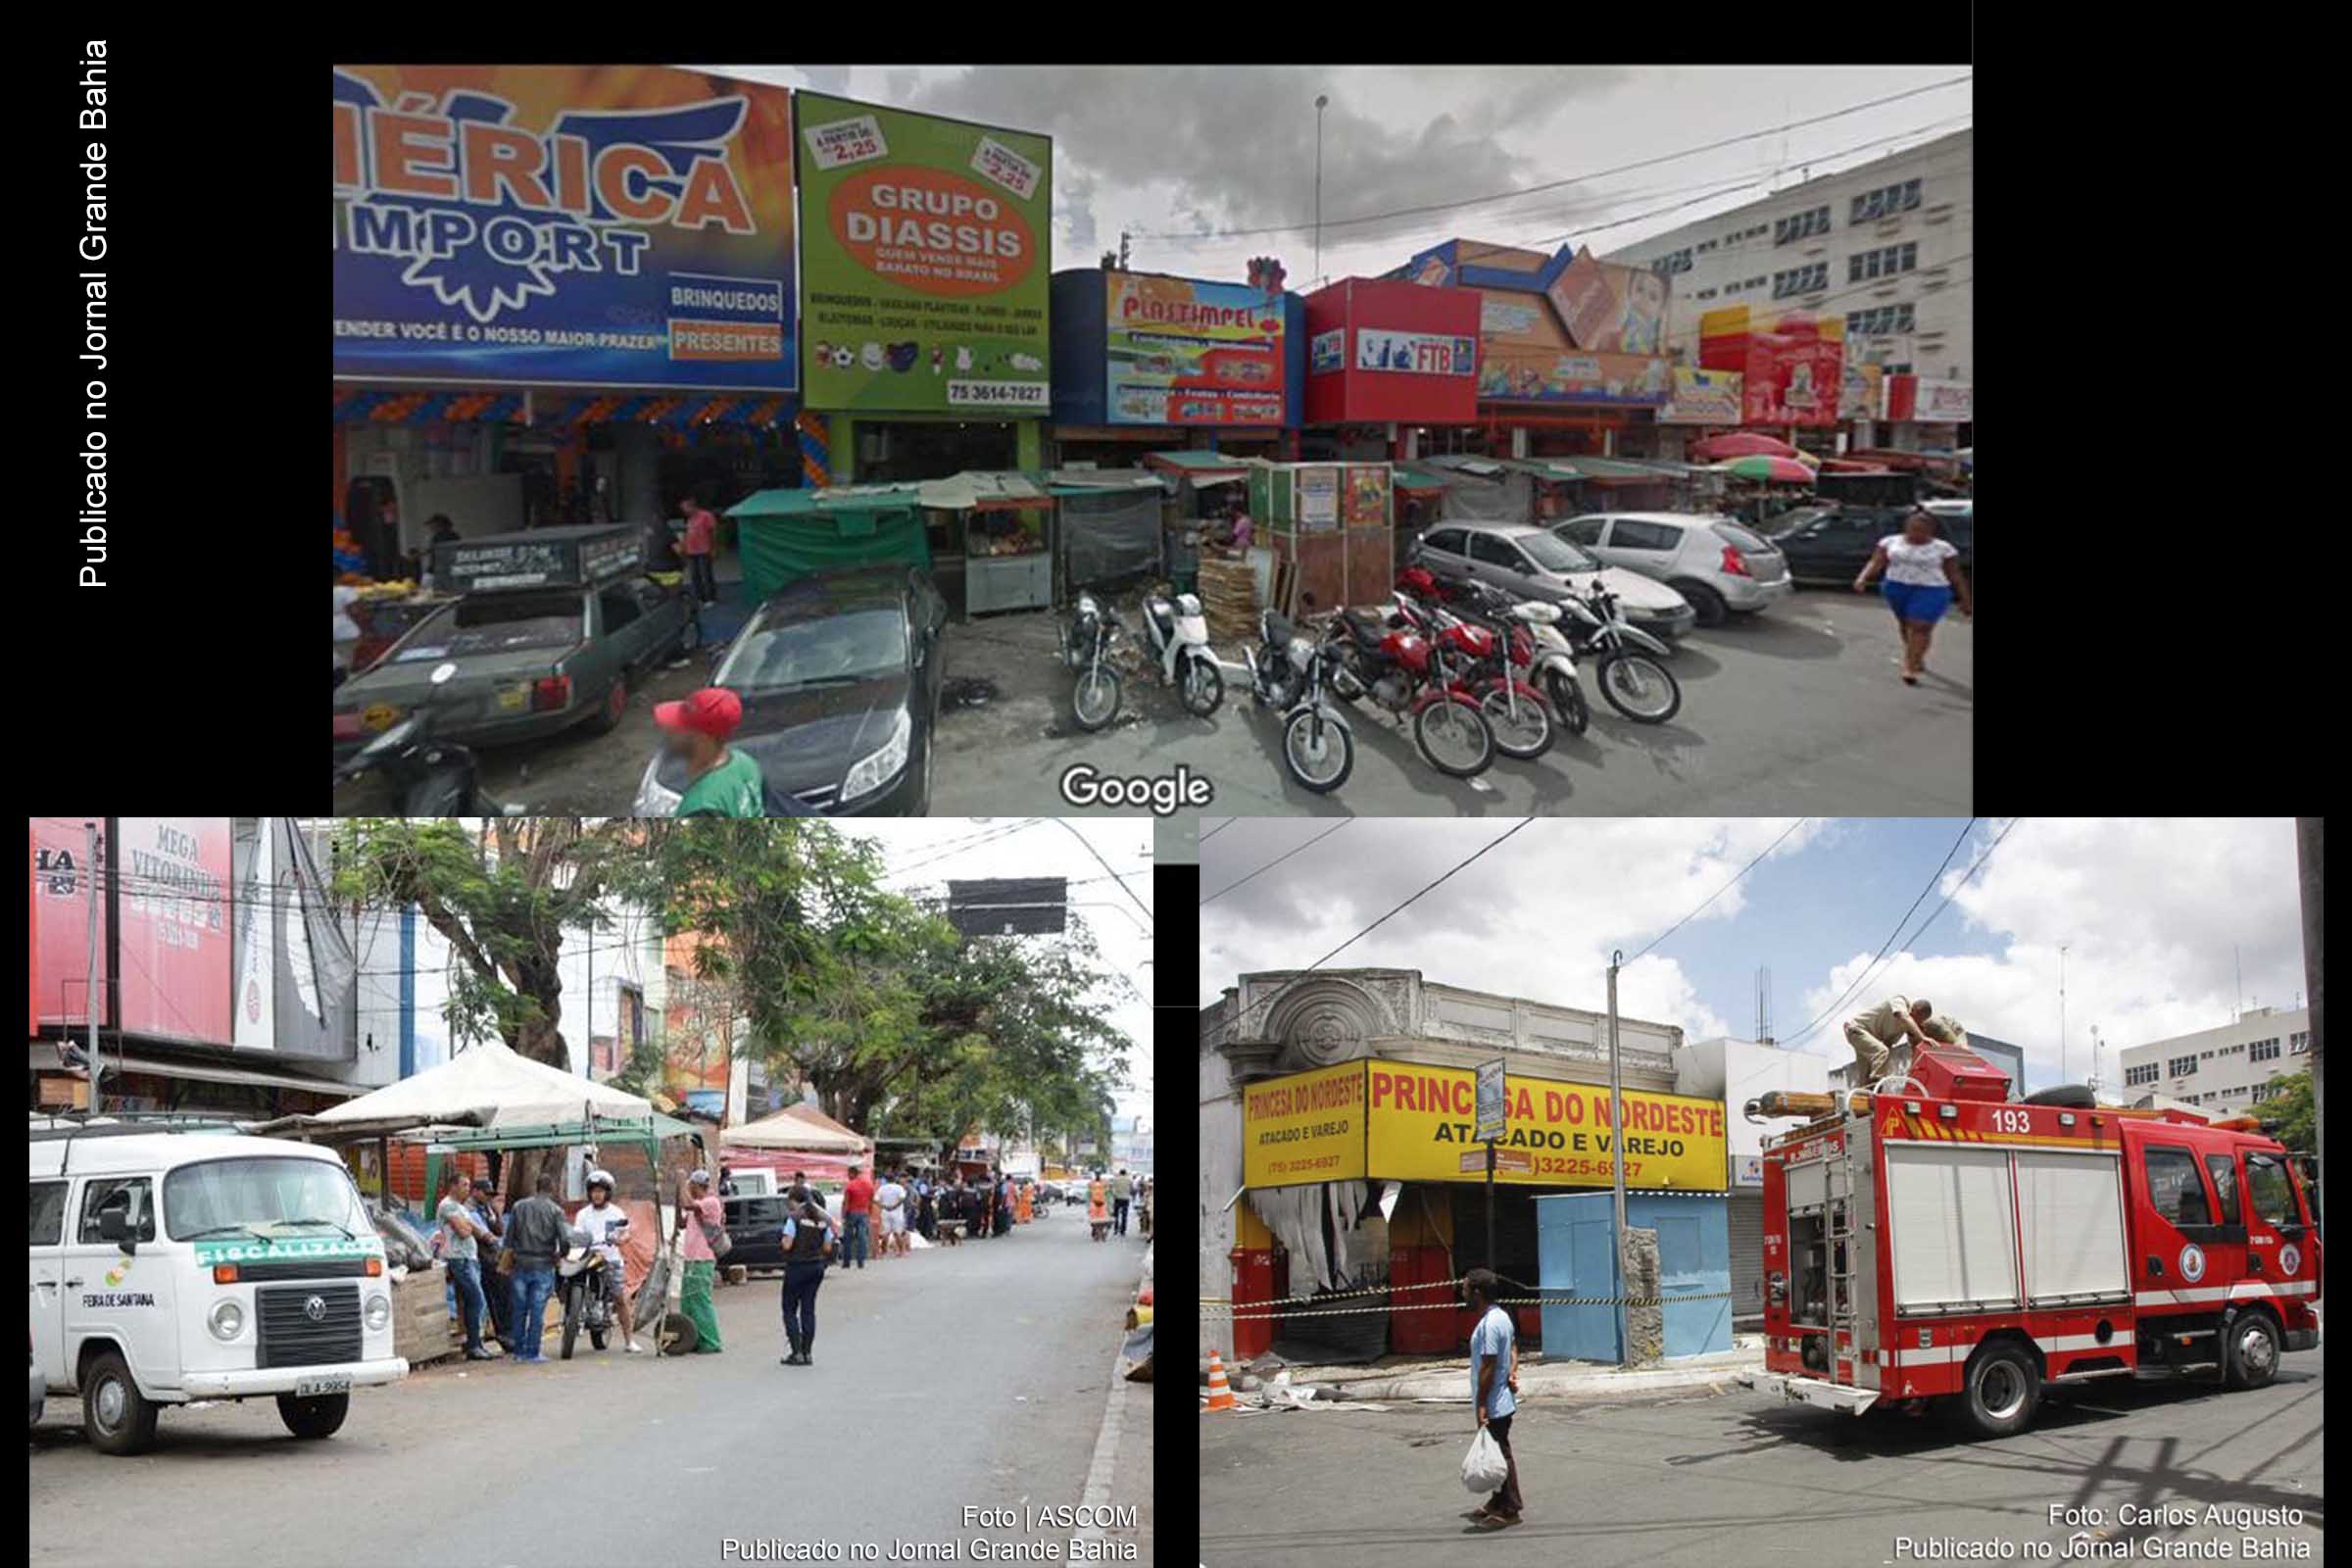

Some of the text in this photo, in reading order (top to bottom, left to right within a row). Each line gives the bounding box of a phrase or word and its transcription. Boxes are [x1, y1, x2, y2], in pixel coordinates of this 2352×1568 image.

[871, 183, 999, 221] GRUPO
[333, 202, 651, 275] MPORT
[847, 211, 1022, 258] DIASSIS
[671, 286, 778, 312] BRINQUEDOS
[466, 326, 480, 342] O
[484, 327, 541, 343] NOSSO
[674, 331, 781, 354] PRESENTES
[1417, 343, 1451, 372] FTB
[950, 384, 968, 400] 75
[157, 824, 198, 862] MEGA
[1248, 1071, 1364, 1122] PRINCESA DO NORDESTE
[1372, 1071, 1536, 1121] PRINCSA
[1544, 1090, 1585, 1126] DO
[1259, 1119, 1349, 1146] ATACADO E VAREJO
[1991, 1108, 2032, 1134] 193
[1434, 1122, 1685, 1157] ATADO E VREJO
